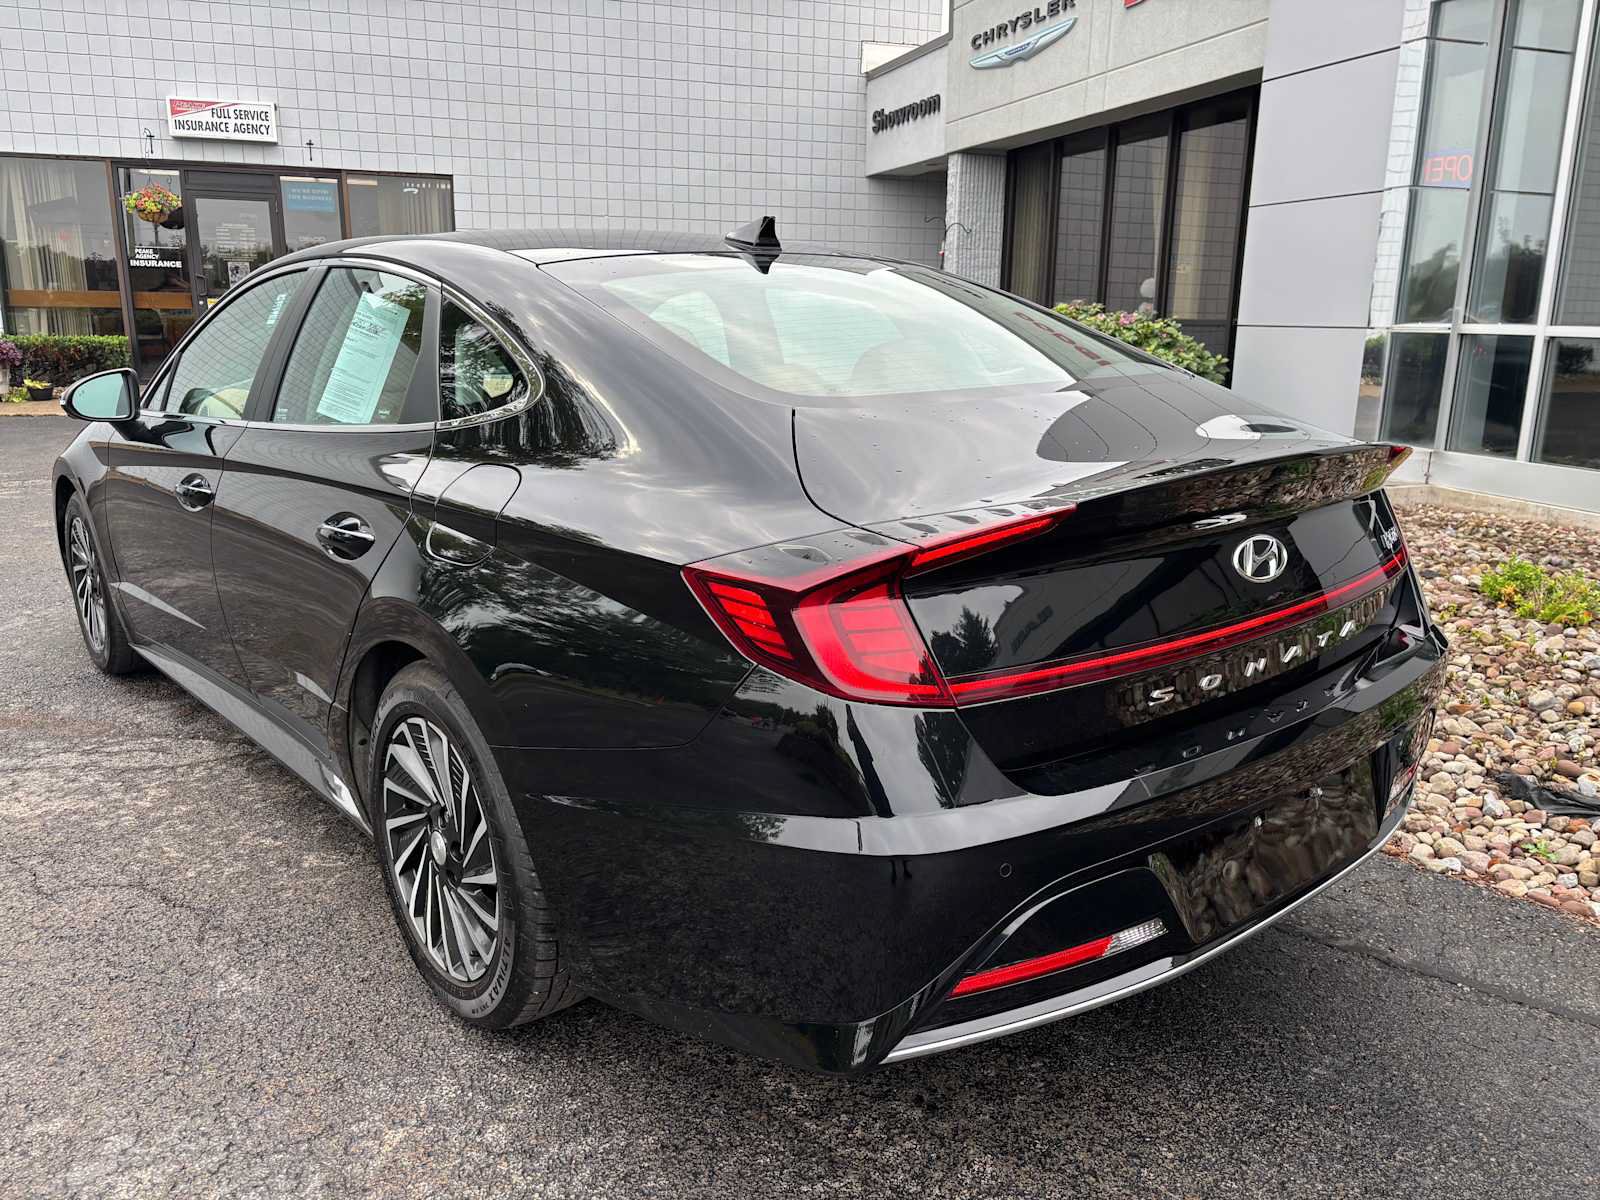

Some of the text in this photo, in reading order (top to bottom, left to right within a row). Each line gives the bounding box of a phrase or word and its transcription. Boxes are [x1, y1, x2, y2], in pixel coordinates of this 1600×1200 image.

[971, 0, 1076, 50] CHRYSLER
[174, 119, 270, 136] INSURANCE AGENCY
[211, 107, 270, 122] FULL SERVICE
[872, 93, 941, 135] Showroom
[130, 259, 183, 269] INSURANCE
[1147, 620, 1357, 707] SONATA
